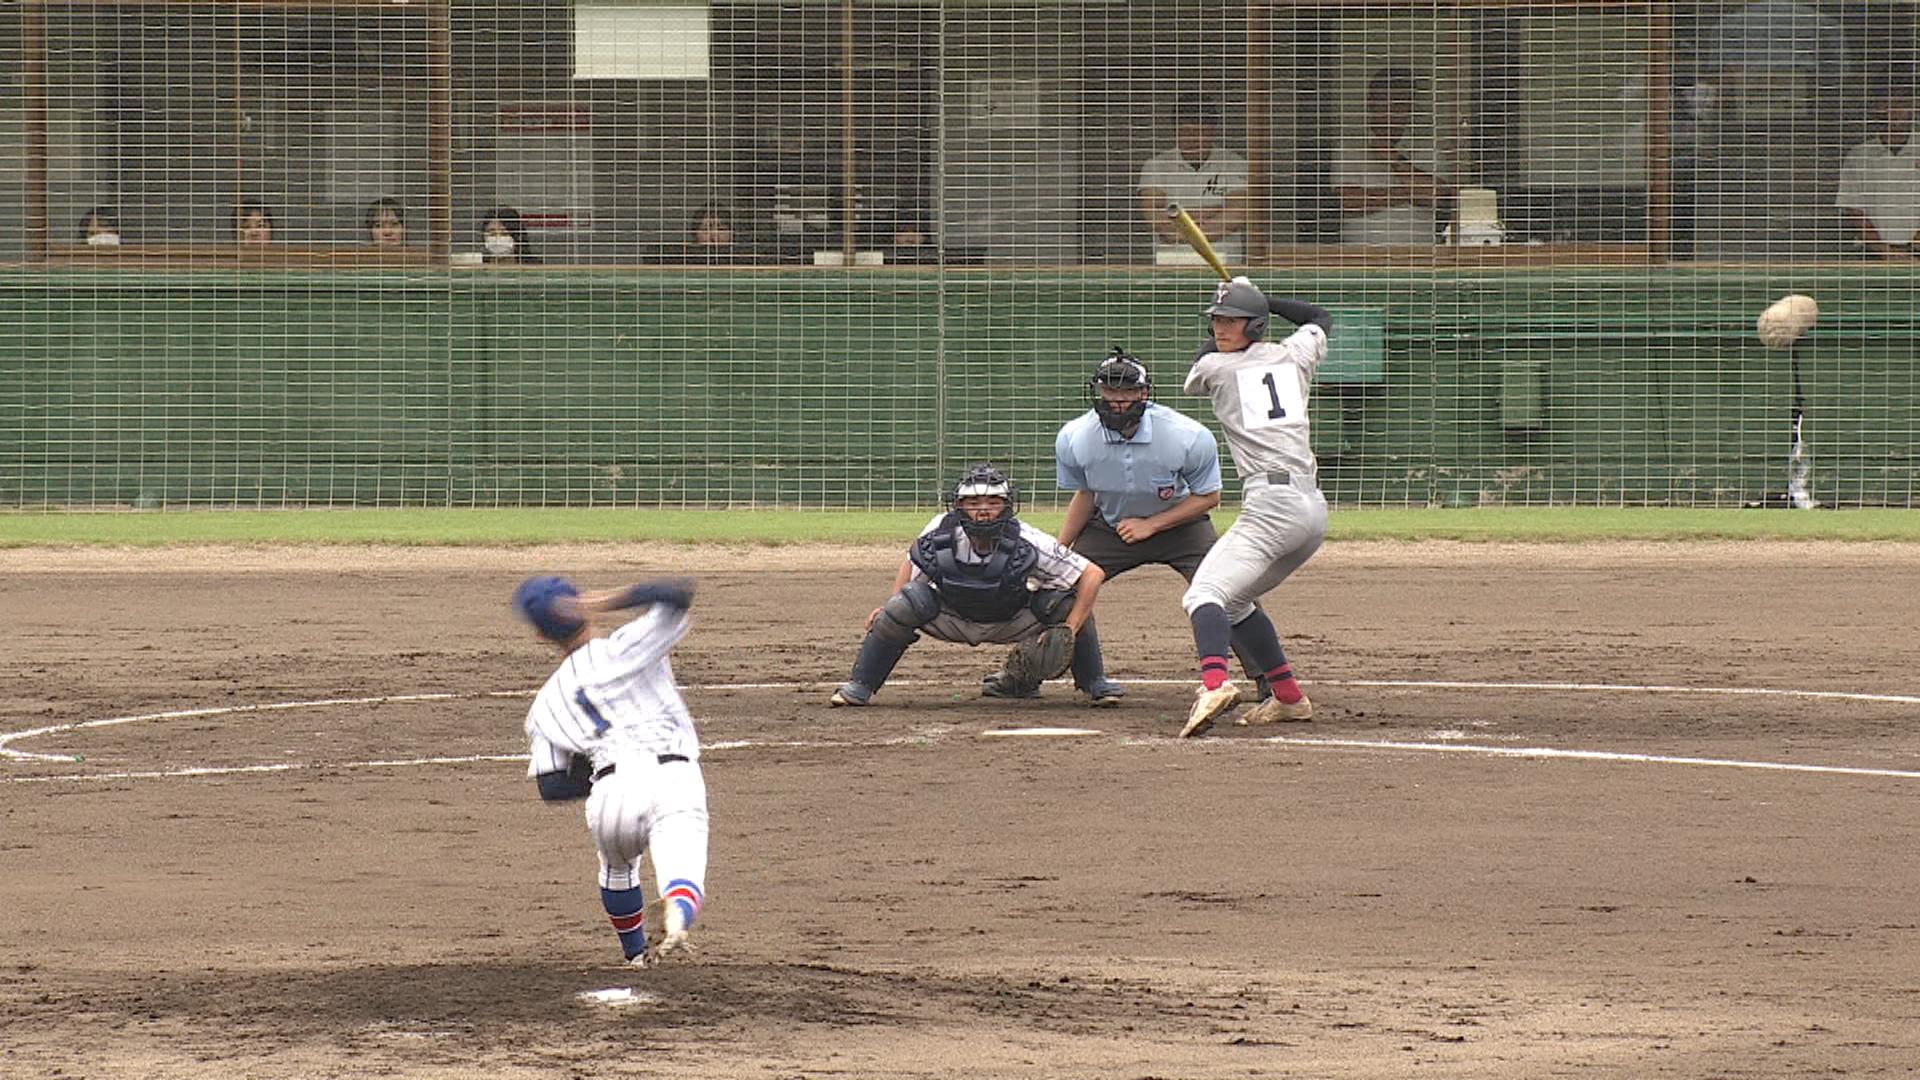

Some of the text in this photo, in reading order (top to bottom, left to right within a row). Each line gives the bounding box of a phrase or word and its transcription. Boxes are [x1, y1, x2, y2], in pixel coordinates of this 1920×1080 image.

[1216, 289, 1229, 304] Y
[1262, 371, 1287, 420] 1
[574, 686, 613, 738] 1
